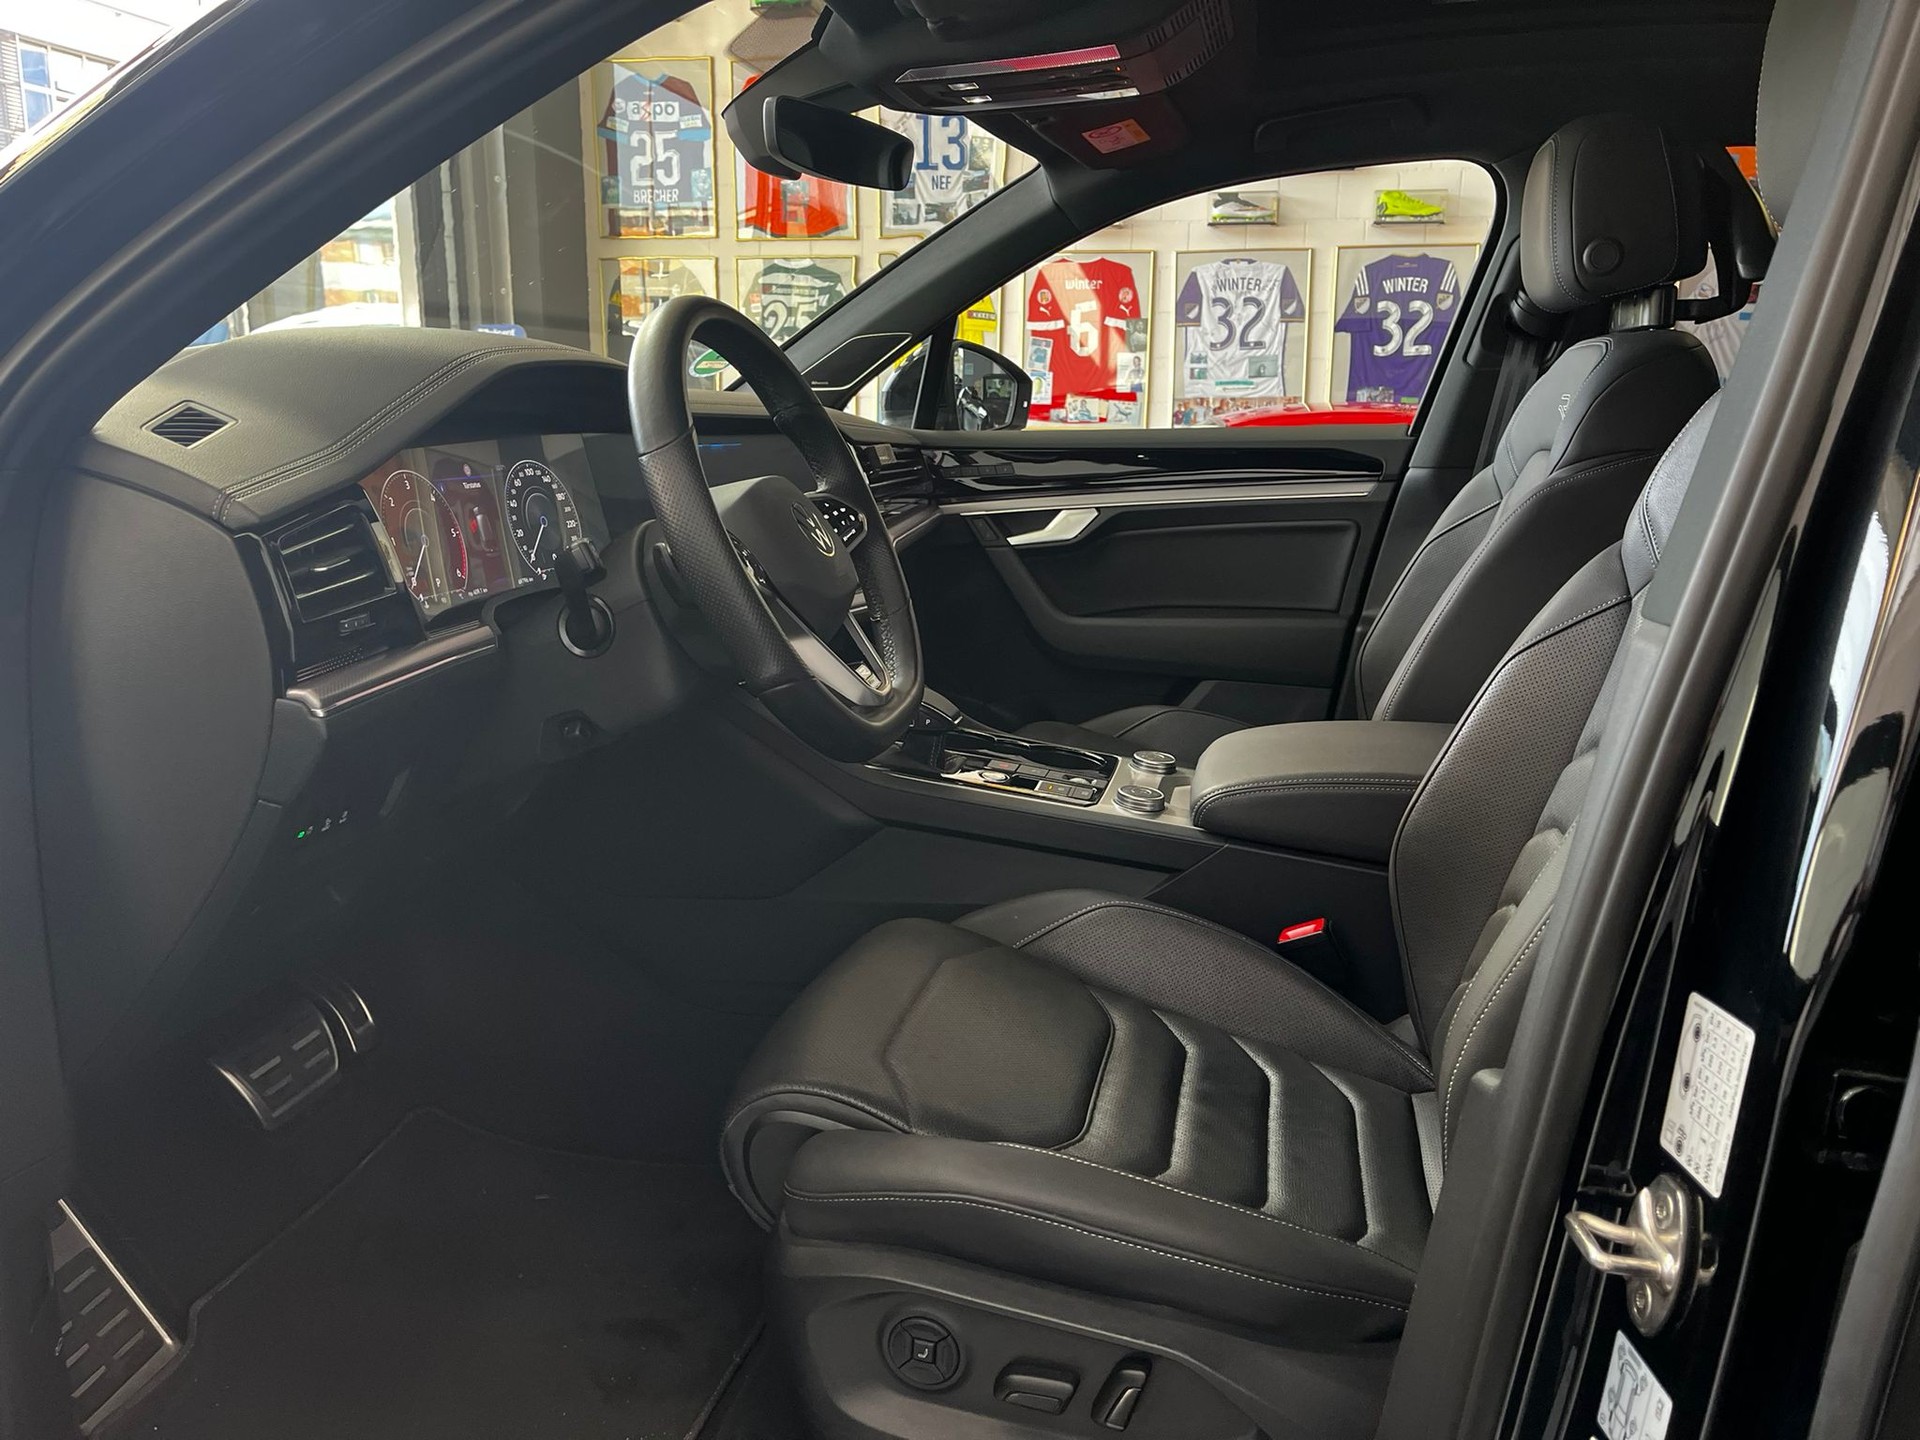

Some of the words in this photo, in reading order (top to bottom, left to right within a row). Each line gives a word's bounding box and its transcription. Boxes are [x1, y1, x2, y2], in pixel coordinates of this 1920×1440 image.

[915, 113, 967, 171] 13
[629, 130, 681, 187] 25
[931, 175, 952, 191] NEF
[632, 189, 680, 204] BRECHER
[1065, 278, 1103, 290] winter
[1216, 277, 1262, 292] WINTER
[1382, 276, 1429, 294] WINTER
[1067, 300, 1100, 357] 6
[1209, 296, 1267, 351] 32
[1373, 300, 1434, 357] 32
[524, 468, 534, 476] 100
[404, 480, 410, 490] 3
[513, 478, 522, 487] 60
[388, 497, 395, 507] 2
[451, 528, 457, 538] 5
[516, 529, 524, 537] 20
[456, 568, 462, 578] 6
